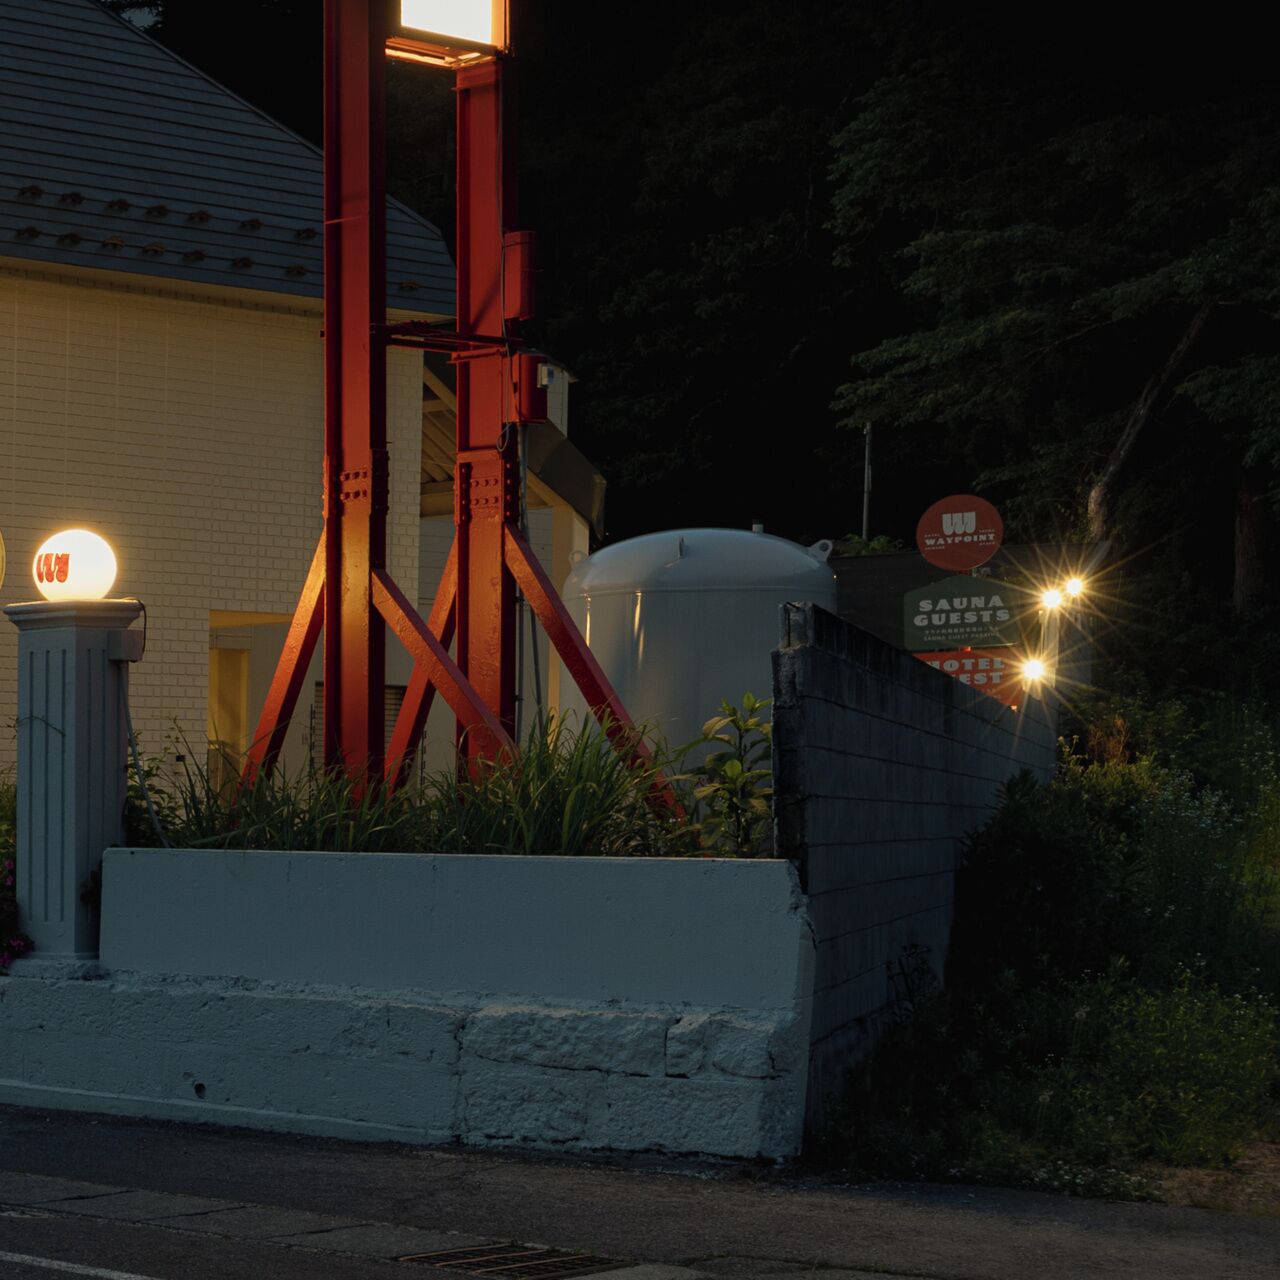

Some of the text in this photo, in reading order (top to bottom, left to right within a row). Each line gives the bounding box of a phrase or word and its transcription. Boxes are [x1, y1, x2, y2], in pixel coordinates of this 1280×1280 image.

[924, 533, 996, 546] WAYPOINT
[919, 595, 1004, 612] SAUNA
[913, 609, 1010, 626] GUESTS
[951, 672, 1003, 685] EST
